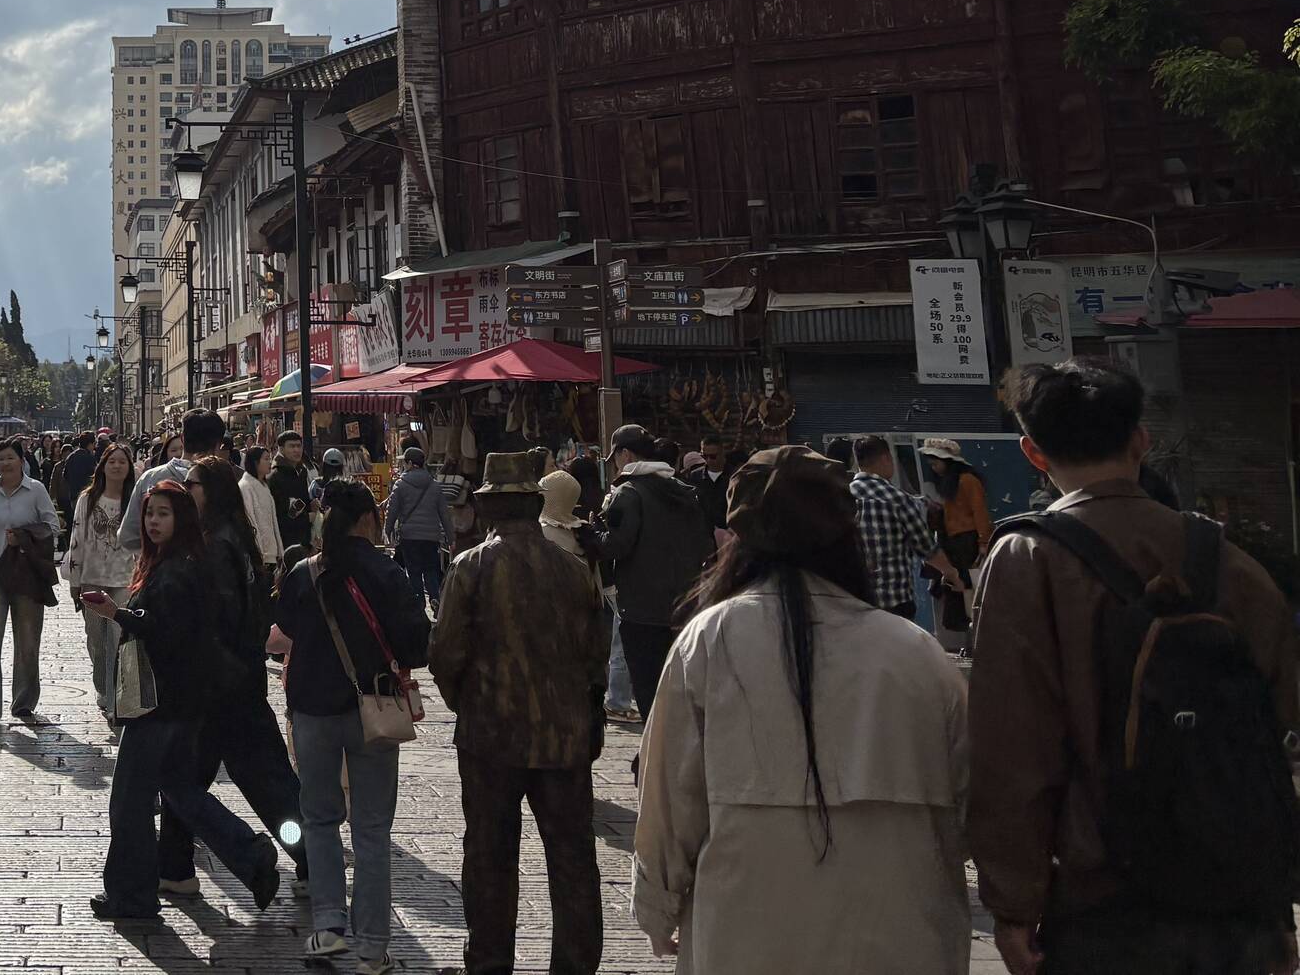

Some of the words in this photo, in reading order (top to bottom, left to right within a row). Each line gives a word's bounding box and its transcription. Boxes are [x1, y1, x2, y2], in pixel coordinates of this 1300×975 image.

[524, 270, 555, 281] 文明街
[643, 271, 685, 282] 文庙直街
[1070, 264, 1149, 279] 昆明市五华区
[652, 291, 676, 300] 卫生间
[404, 270, 474, 343] 刻章
[479, 293, 499, 314] 雨伞
[536, 311, 560, 321] 卫生间
[637, 312, 677, 322] 地下停车场
